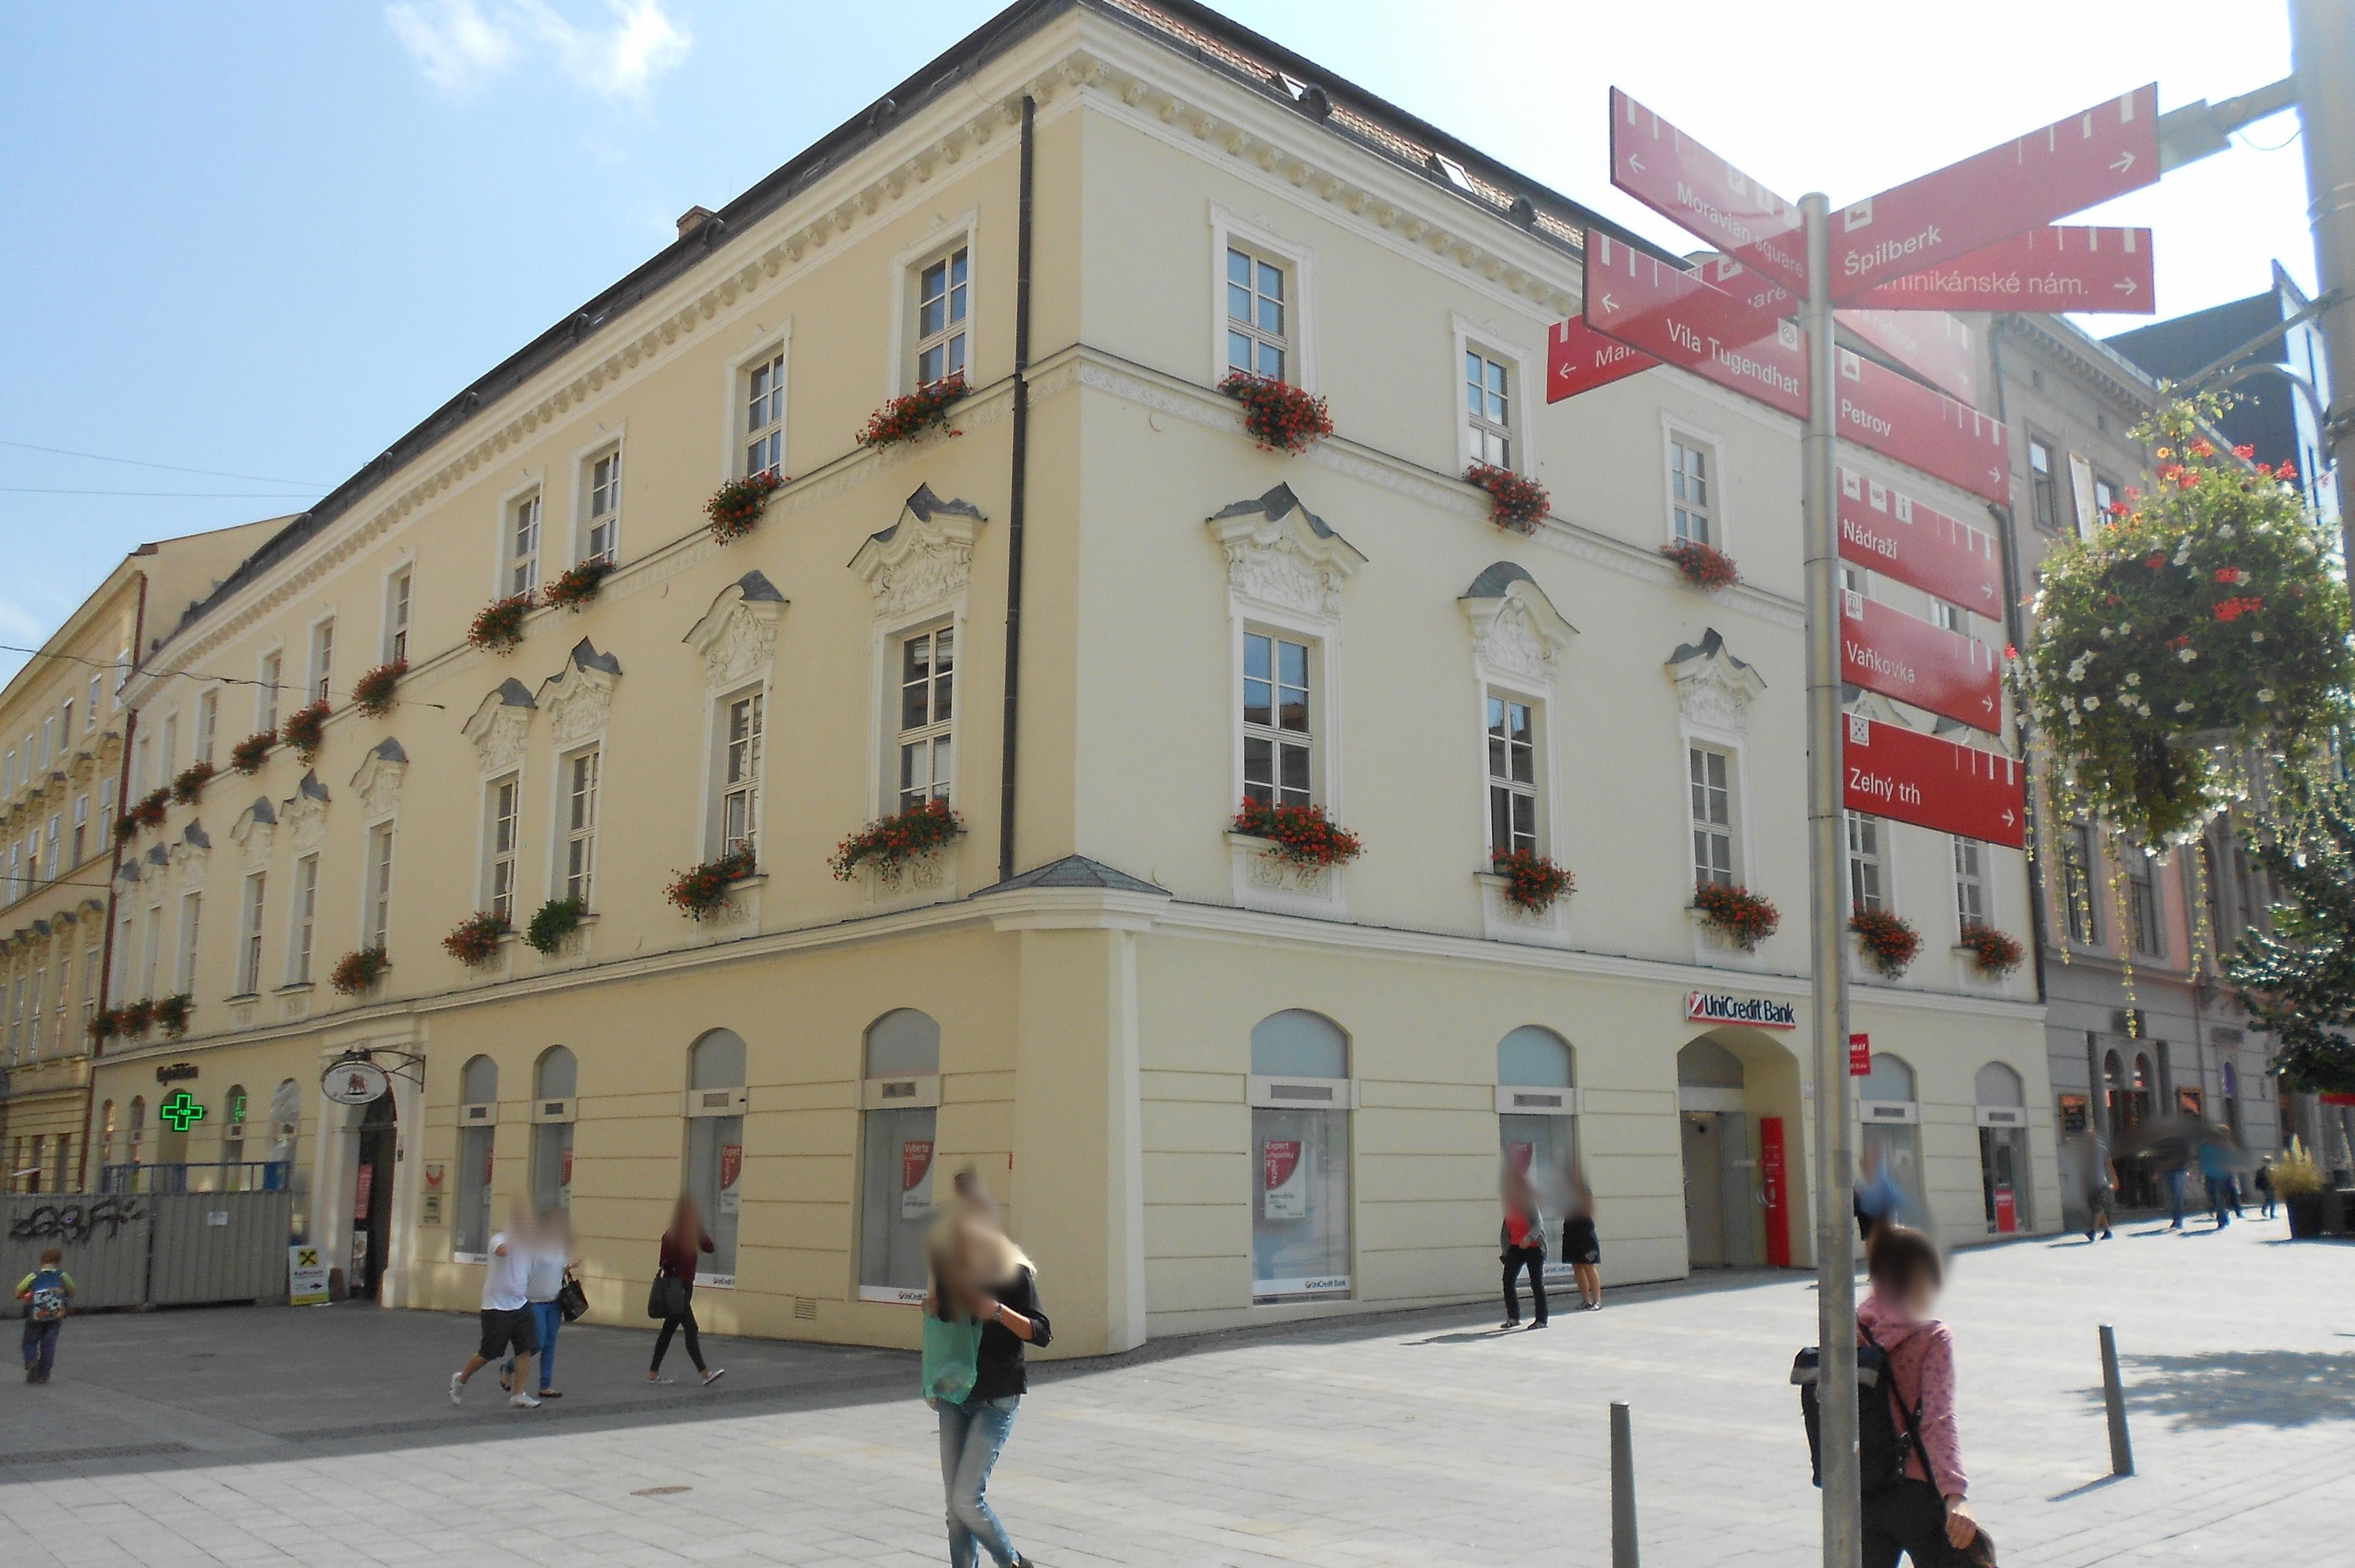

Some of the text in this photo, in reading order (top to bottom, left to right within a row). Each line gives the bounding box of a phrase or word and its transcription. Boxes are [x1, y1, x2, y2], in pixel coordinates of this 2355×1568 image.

[1677, 180, 1804, 278] Moravian square
[1845, 224, 1942, 277] Špilberk
[2029, 273, 2089, 295] nám.
[1667, 318, 1800, 397] Vila Tugendhat
[1842, 398, 1892, 437] Petrov
[1843, 519, 1898, 560] Nádraží
[1847, 640, 1915, 683] Vaňkovka
[1850, 768, 1921, 806] Zelný trh
[1704, 994, 1796, 1023] UniCredit Bank
[1266, 1142, 1289, 1151] Expert
